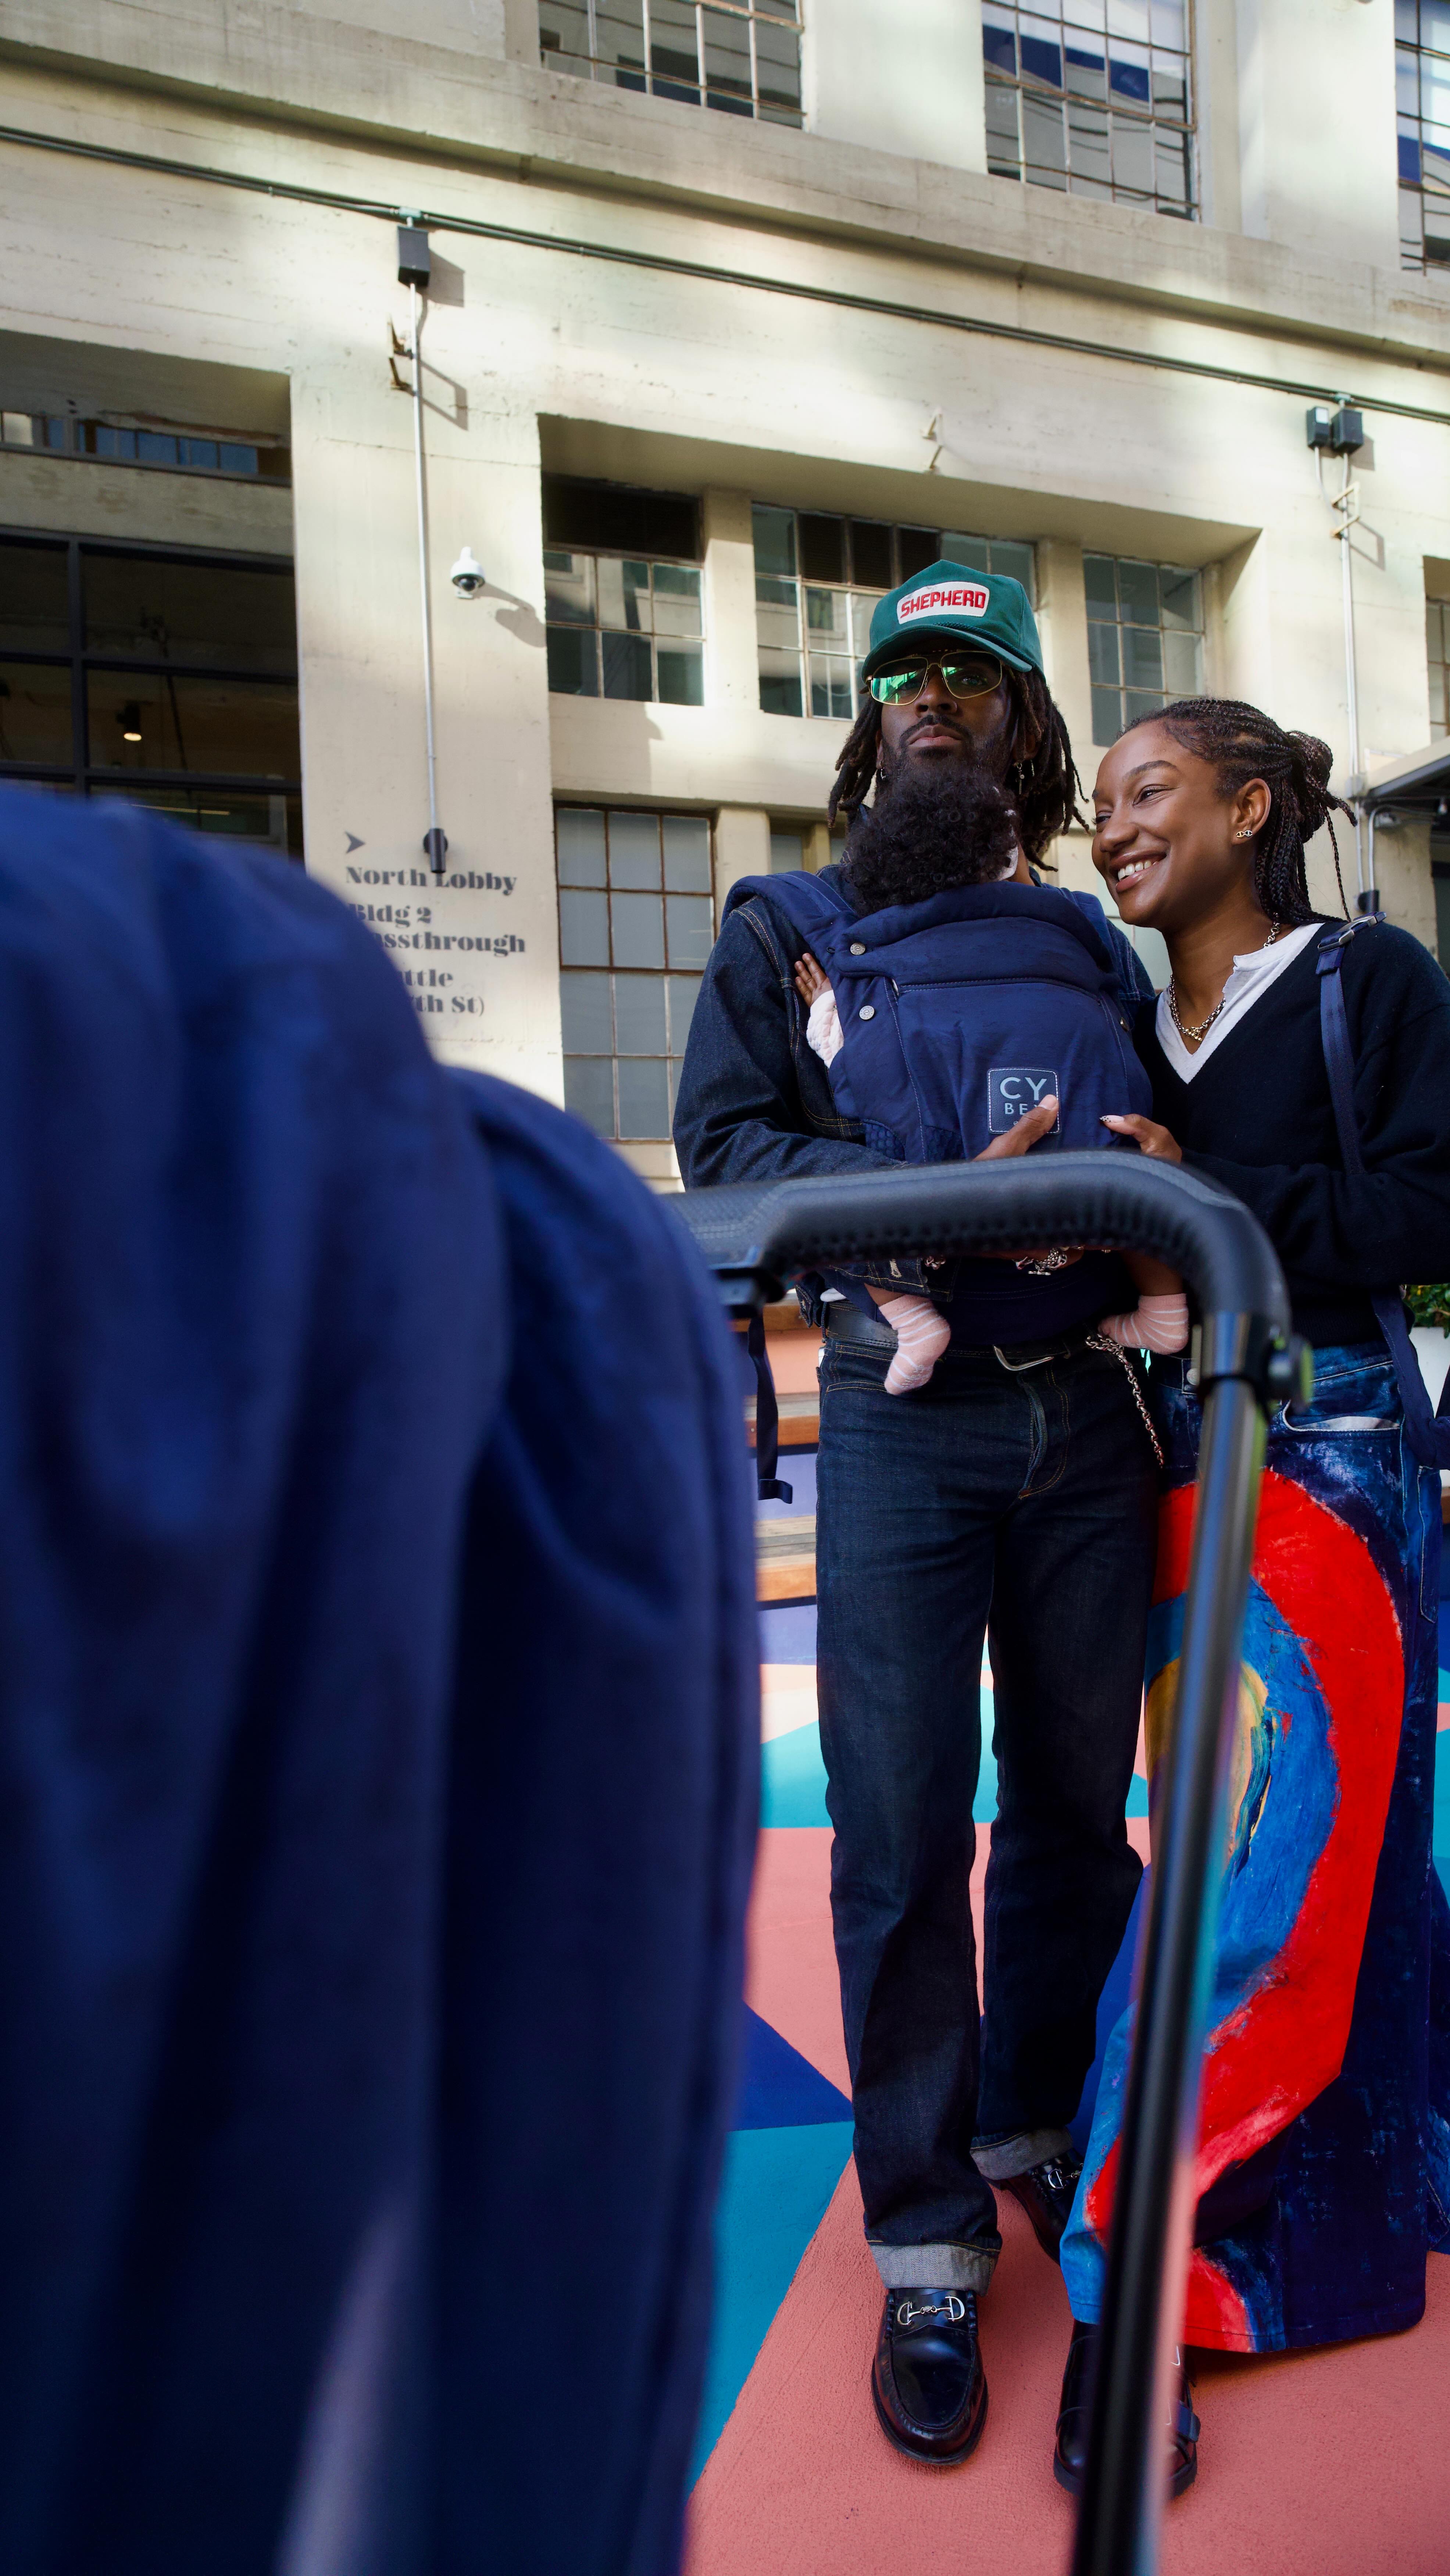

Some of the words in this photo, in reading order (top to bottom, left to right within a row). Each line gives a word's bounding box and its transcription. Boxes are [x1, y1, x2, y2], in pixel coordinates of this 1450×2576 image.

[900, 590, 986, 618] SHEPHERD
[346, 866, 427, 887] North
[435, 871, 517, 896] Lobby
[417, 907, 432, 924] 2
[375, 931, 525, 957] ssthrough
[399, 969, 453, 987] ttle
[451, 995, 485, 1016] St)
[1000, 1077, 1047, 1101] CY
[1005, 1103, 1038, 1115] BE
